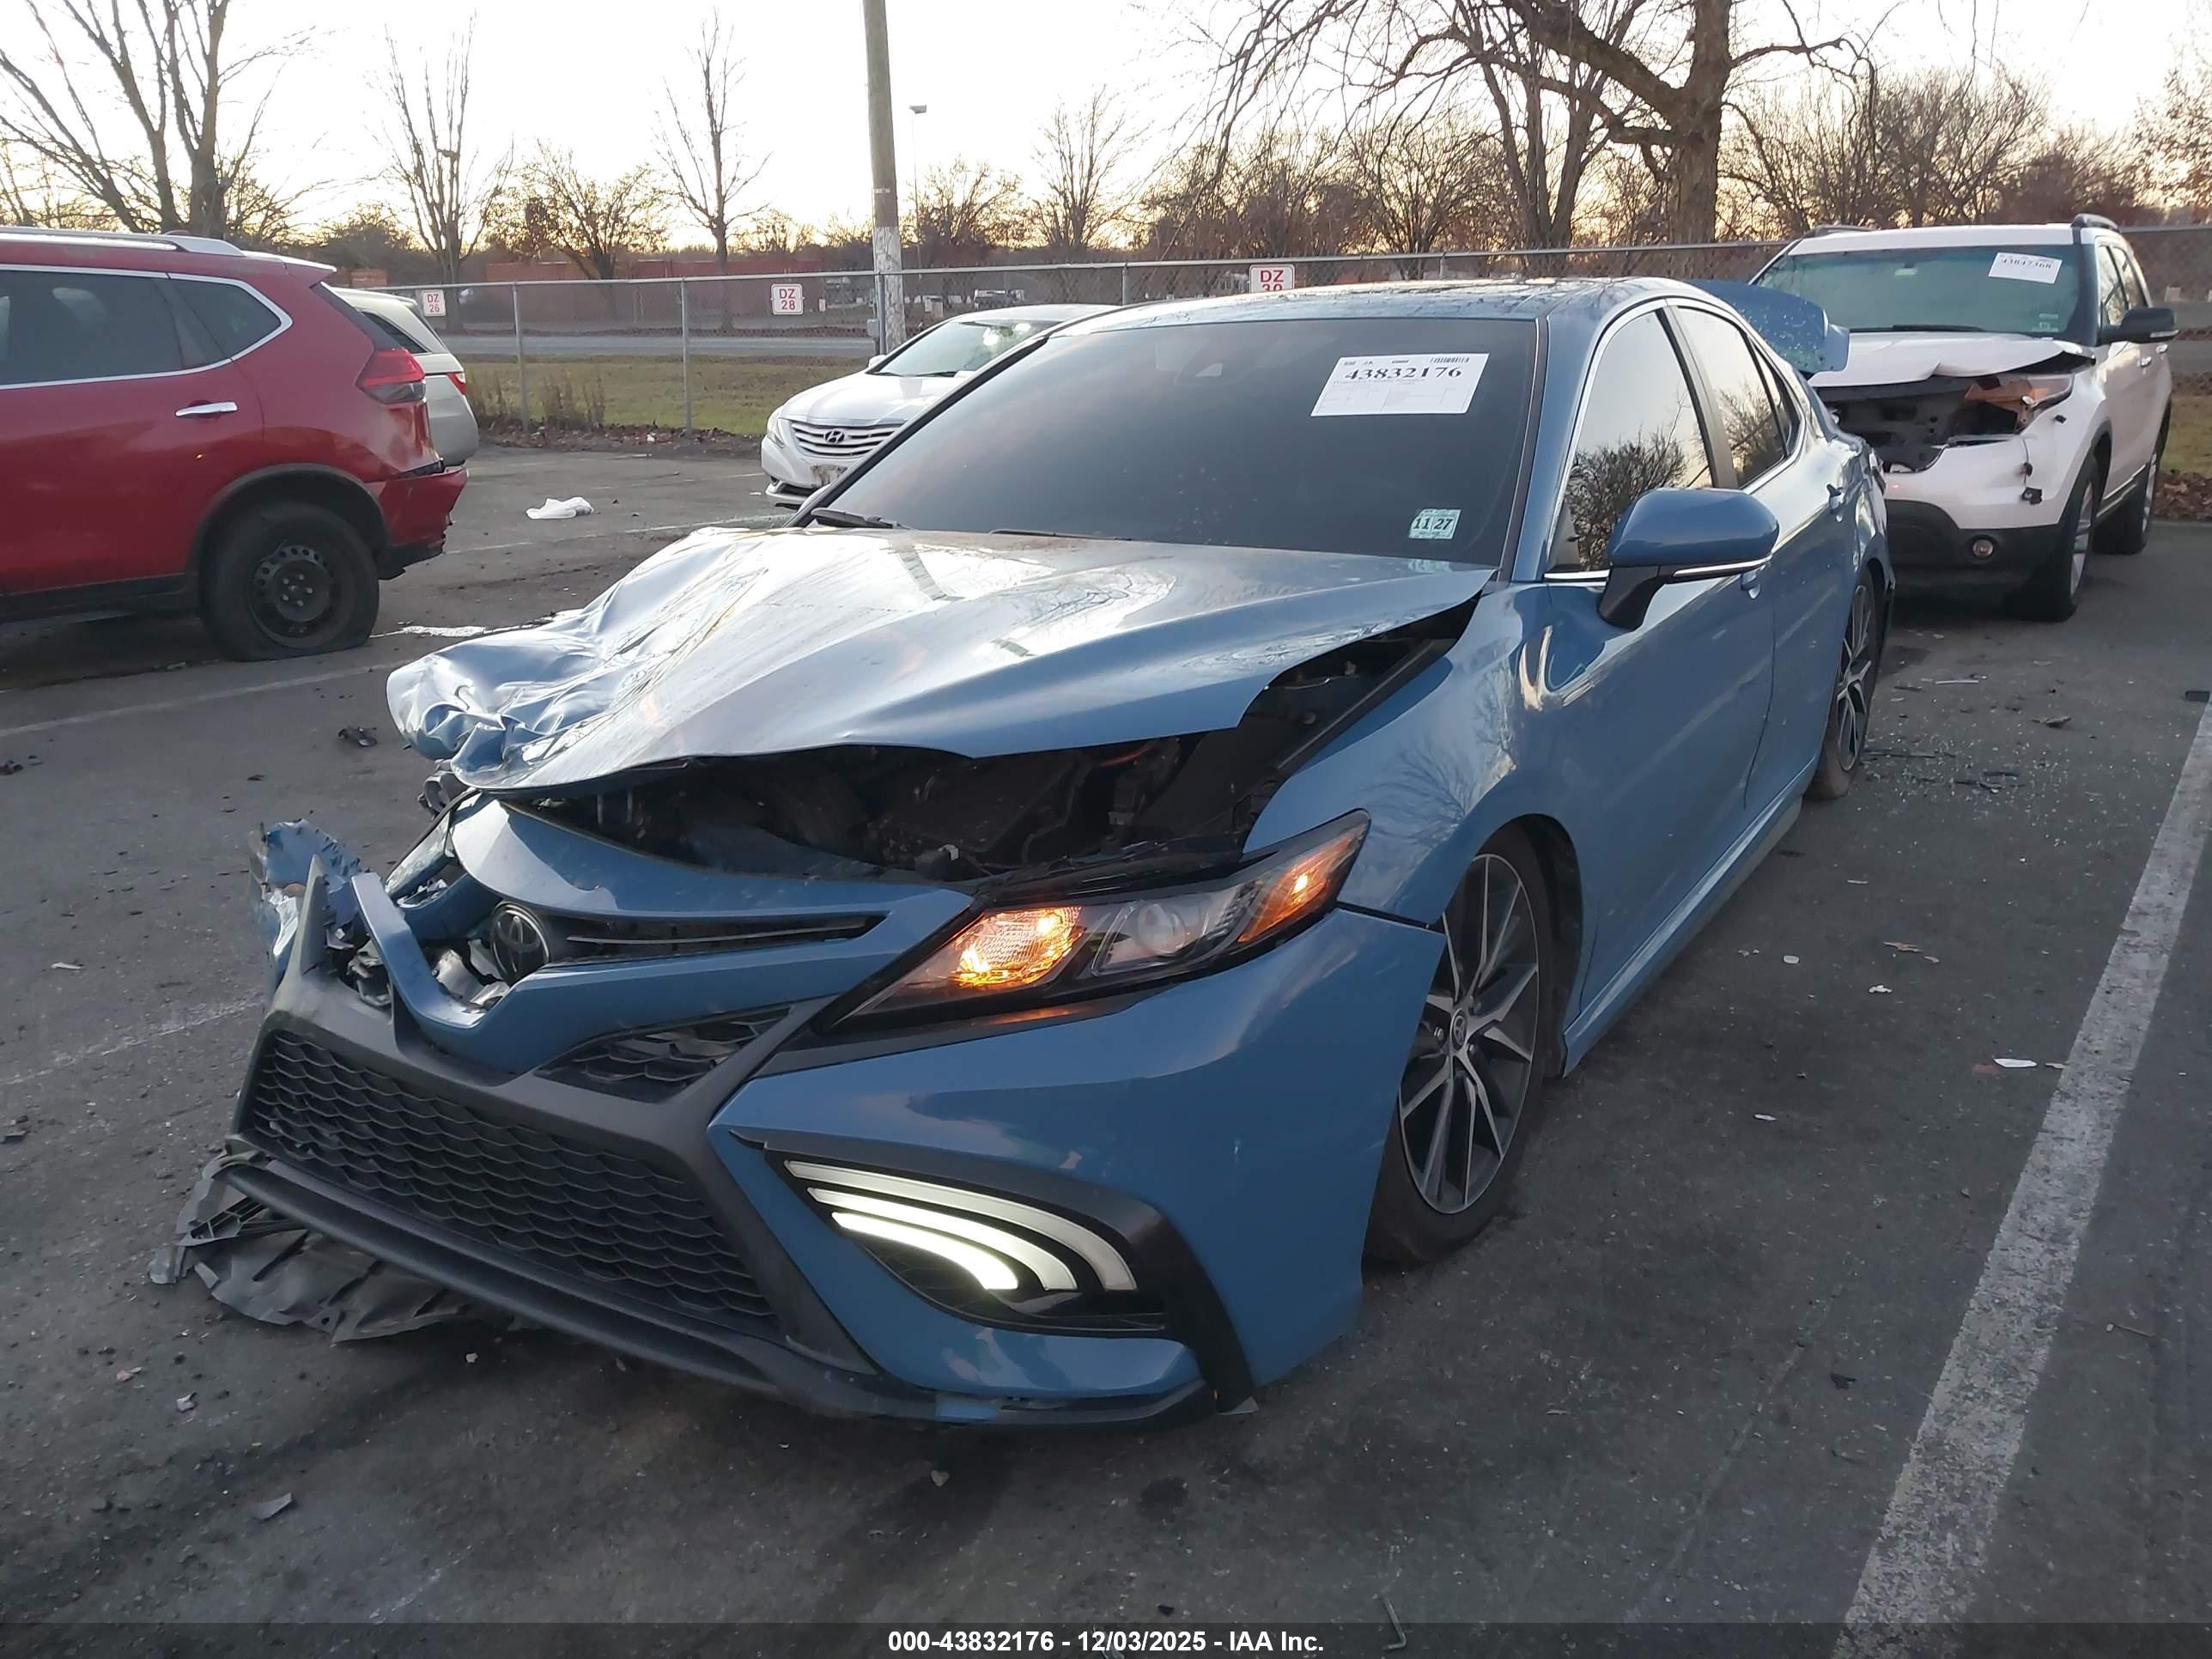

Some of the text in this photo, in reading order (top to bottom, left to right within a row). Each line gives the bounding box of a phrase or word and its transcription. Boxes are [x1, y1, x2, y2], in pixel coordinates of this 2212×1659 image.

[1261, 270, 1284, 283] DZ
[427, 294, 440, 303] DZ
[779, 289, 795, 299] DZ
[428, 304, 440, 313] 26
[781, 300, 795, 310] 28
[1344, 367, 1462, 380] 43832176
[1413, 517, 1454, 530] 11 27
